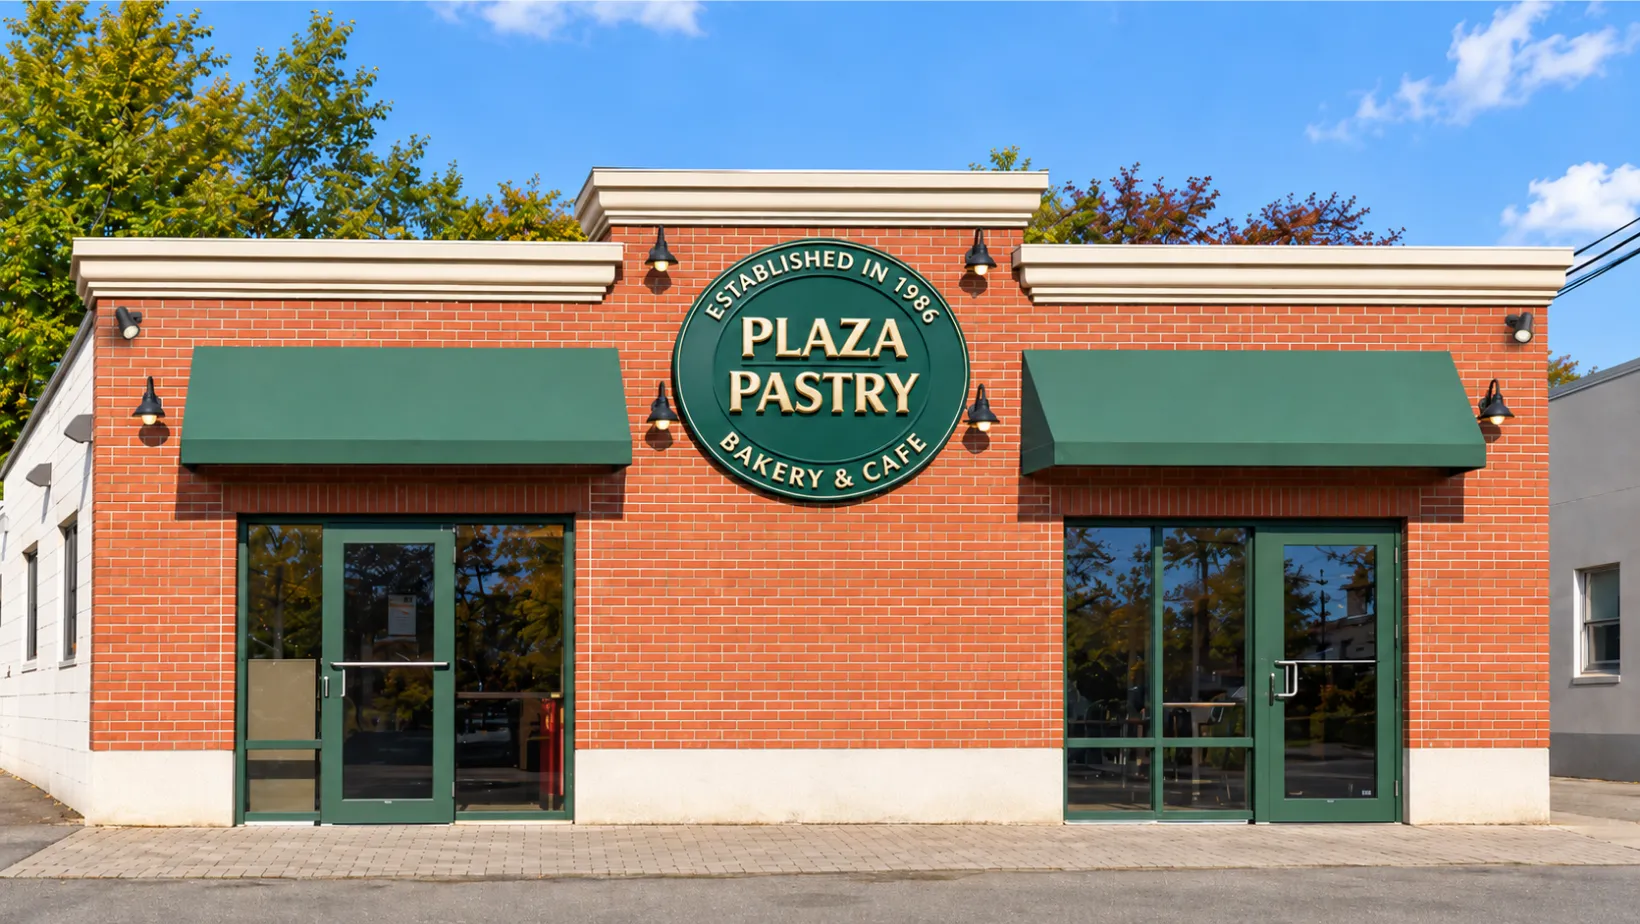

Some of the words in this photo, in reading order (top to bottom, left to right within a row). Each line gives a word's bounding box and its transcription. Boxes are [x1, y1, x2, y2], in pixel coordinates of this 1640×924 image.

[705, 250, 854, 321] ESTABLISHED
[861, 258, 889, 283] IN
[893, 276, 940, 324] 1986
[741, 316, 909, 359] PLAZA
[728, 370, 920, 414] PASTRY
[719, 431, 823, 489] BAKERY
[834, 468, 854, 489] &
[862, 432, 928, 482] CAFE
